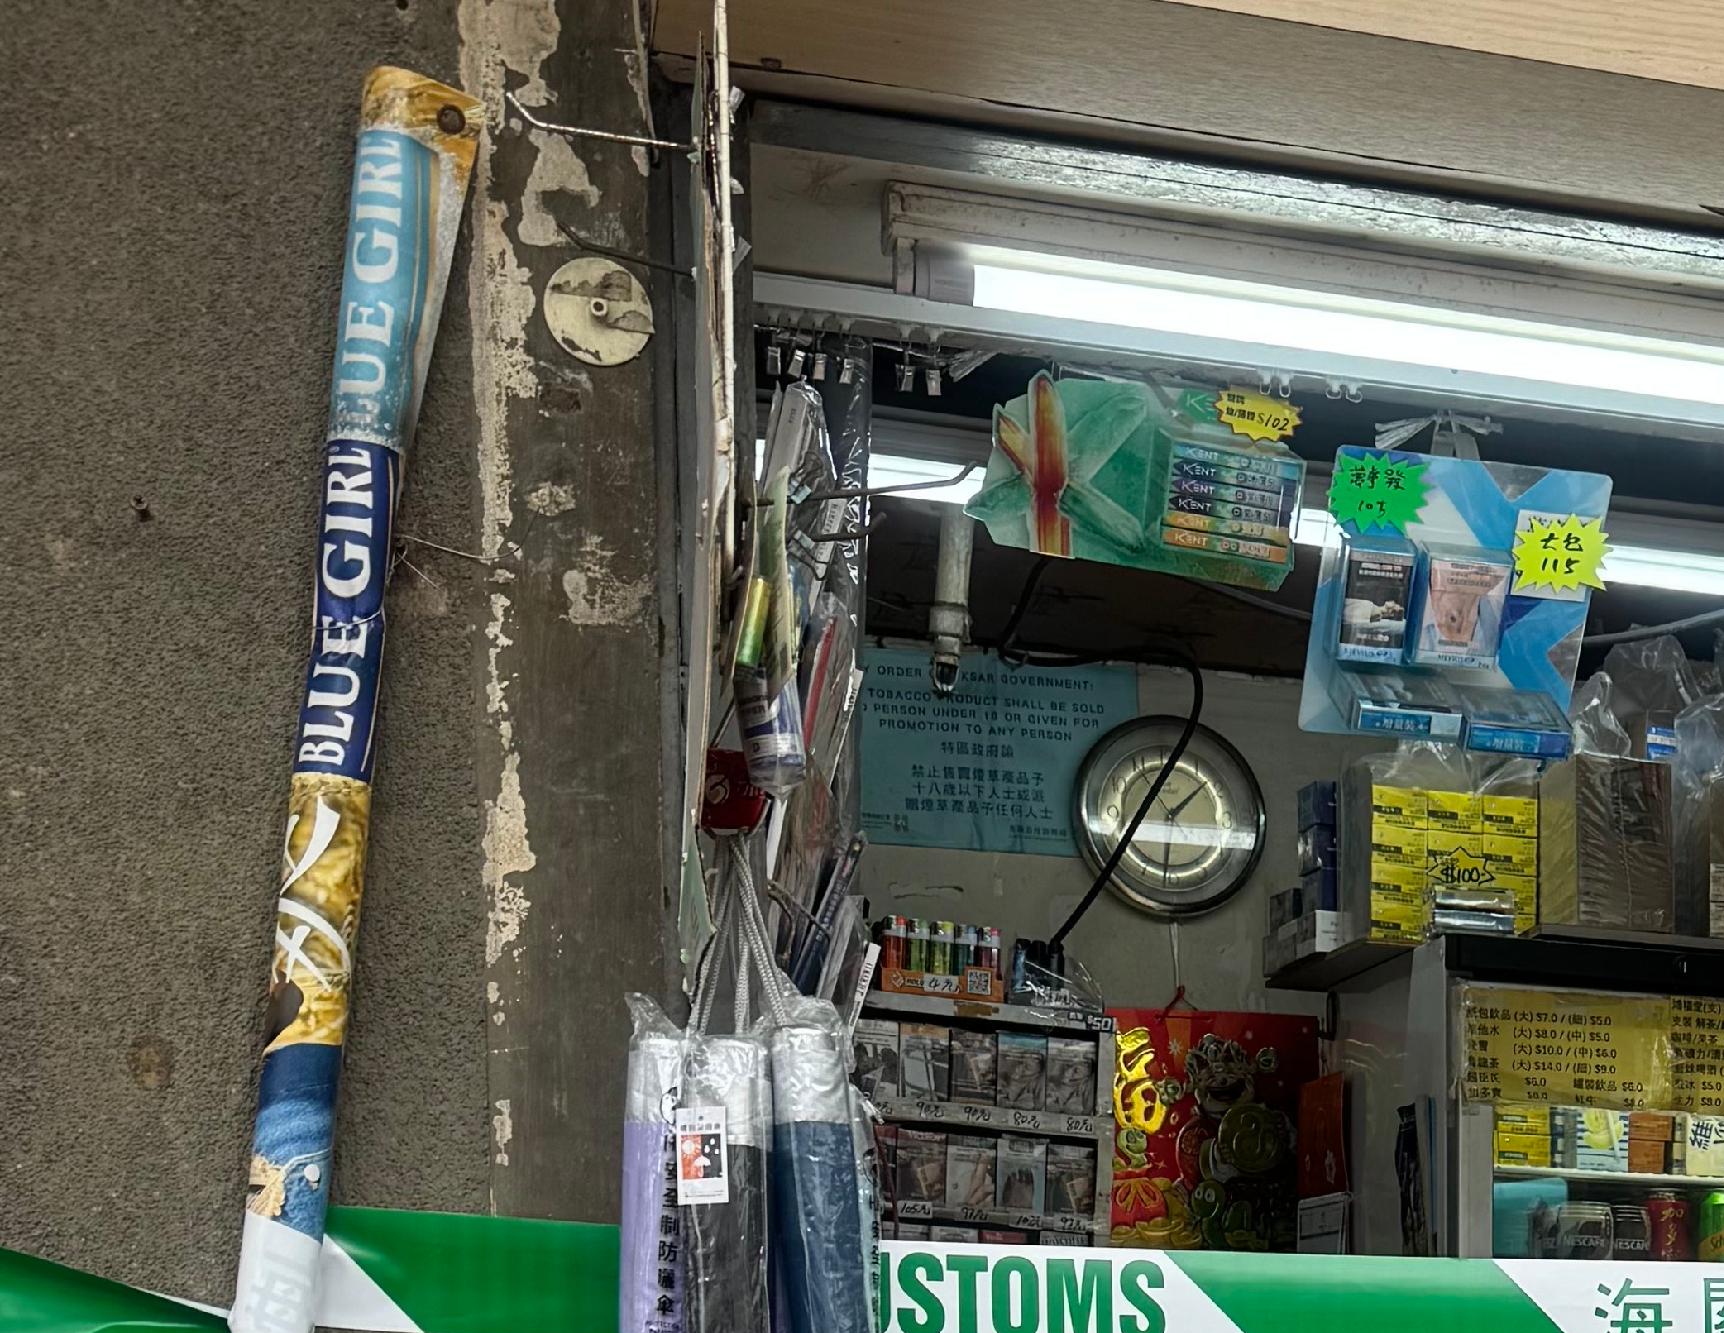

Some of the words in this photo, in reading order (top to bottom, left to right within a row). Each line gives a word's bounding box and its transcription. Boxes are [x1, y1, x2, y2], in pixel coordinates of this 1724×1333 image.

[352, 135, 403, 287] GIRL
[1183, 448, 1219, 461] KENT
[1183, 462, 1217, 478] KENT
[1181, 480, 1216, 495] KENT
[1178, 498, 1212, 512] KENT
[321, 443, 373, 599] GIRL
[1176, 518, 1212, 530] KENT
[1174, 532, 1208, 547] KENT
[1541, 558, 1581, 576] 115
[877, 664, 922, 678] ORDER
[960, 672, 995, 684] KSAR
[1000, 673, 1094, 691] GOVERNMENT:
[298, 610, 370, 767] BLUE
[867, 687, 932, 703] TOBACCO
[1003, 694, 1045, 711] SHALL
[1050, 698, 1067, 712] BE
[1071, 701, 1105, 715] SOLD
[873, 701, 926, 717] PERSON
[932, 706, 977, 720] UNDER
[1004, 710, 1022, 723] OR
[1027, 711, 1070, 726] GIVEN
[1073, 715, 1099, 729] FOR
[879, 717, 960, 734] PROMOTION
[966, 722, 983, 736] TO
[988, 723, 1014, 738] ANY
[1020, 726, 1073, 742] PERSON
